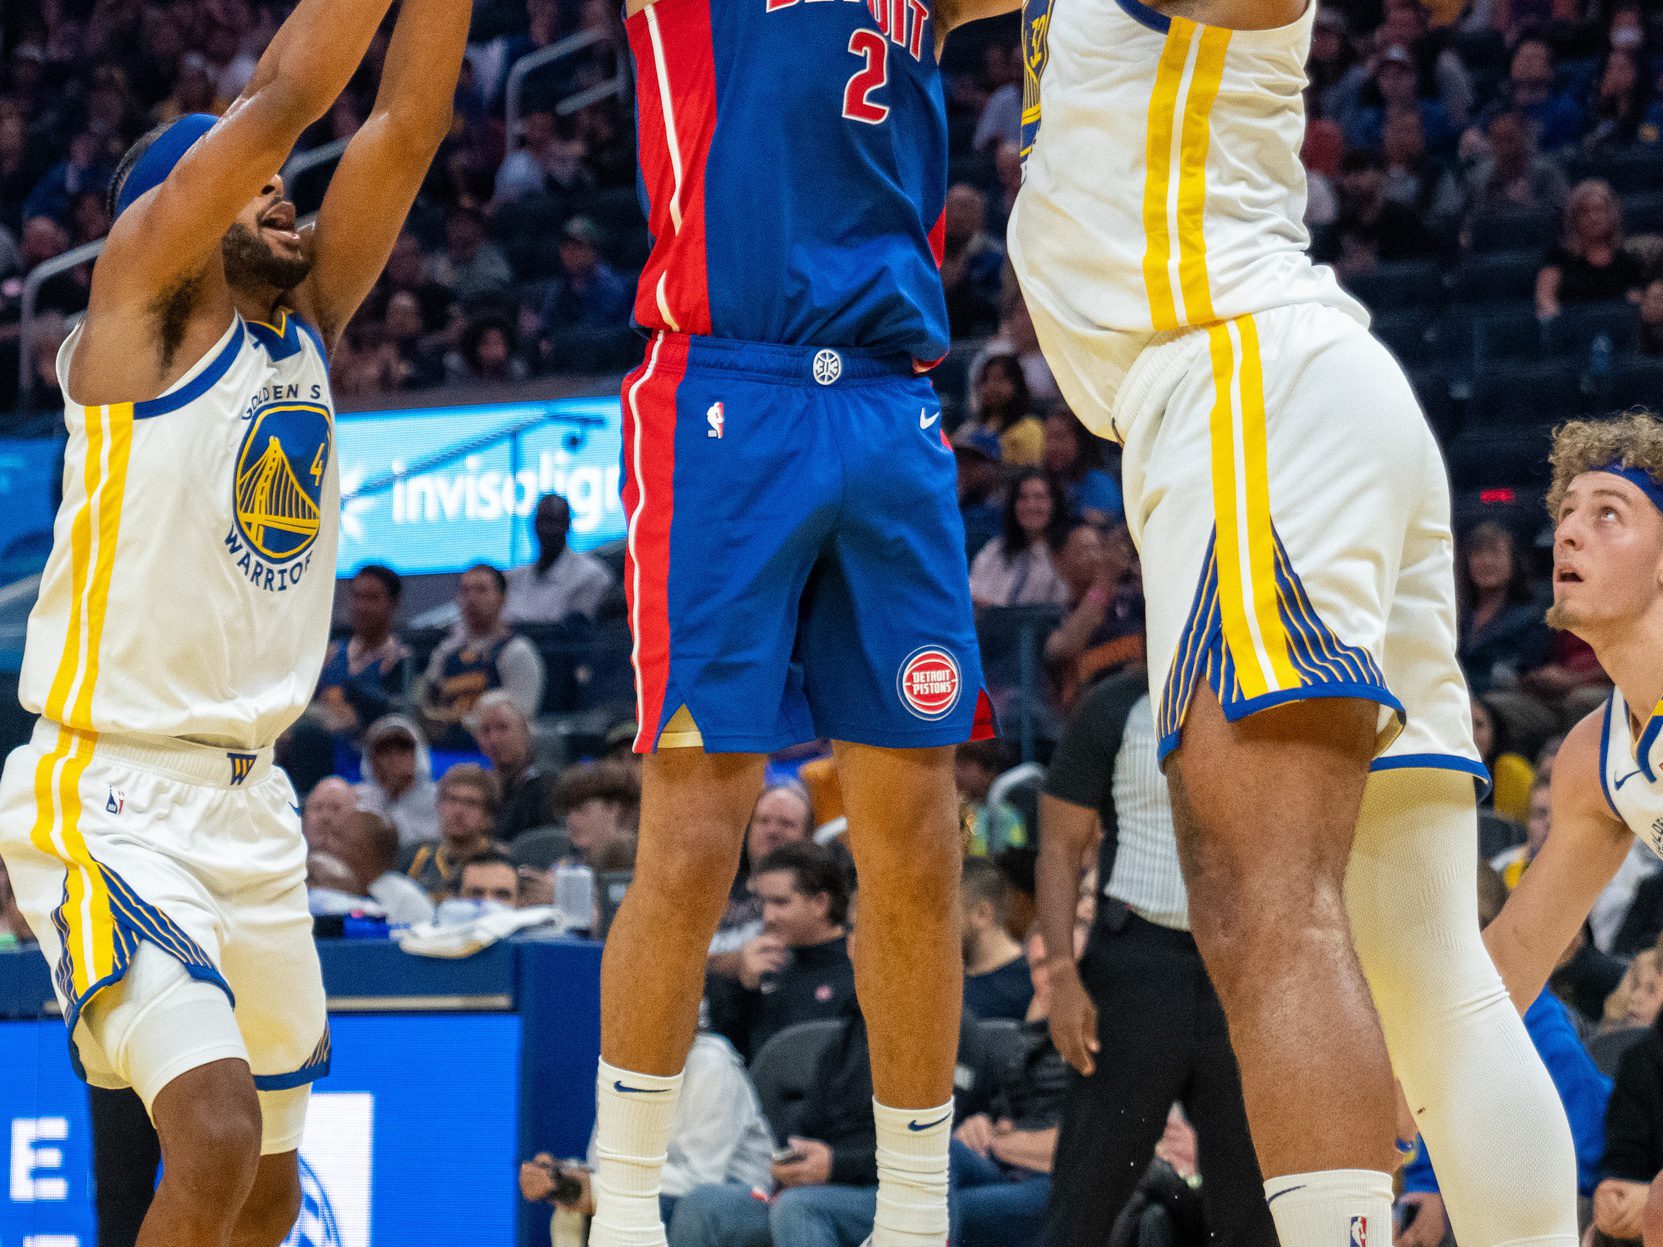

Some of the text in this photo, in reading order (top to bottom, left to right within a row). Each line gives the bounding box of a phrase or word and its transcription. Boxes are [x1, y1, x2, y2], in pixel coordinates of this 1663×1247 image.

[841, 28, 889, 125] 2
[911, 669, 951, 683] DETROIT
[911, 681, 952, 695] PISTONS
